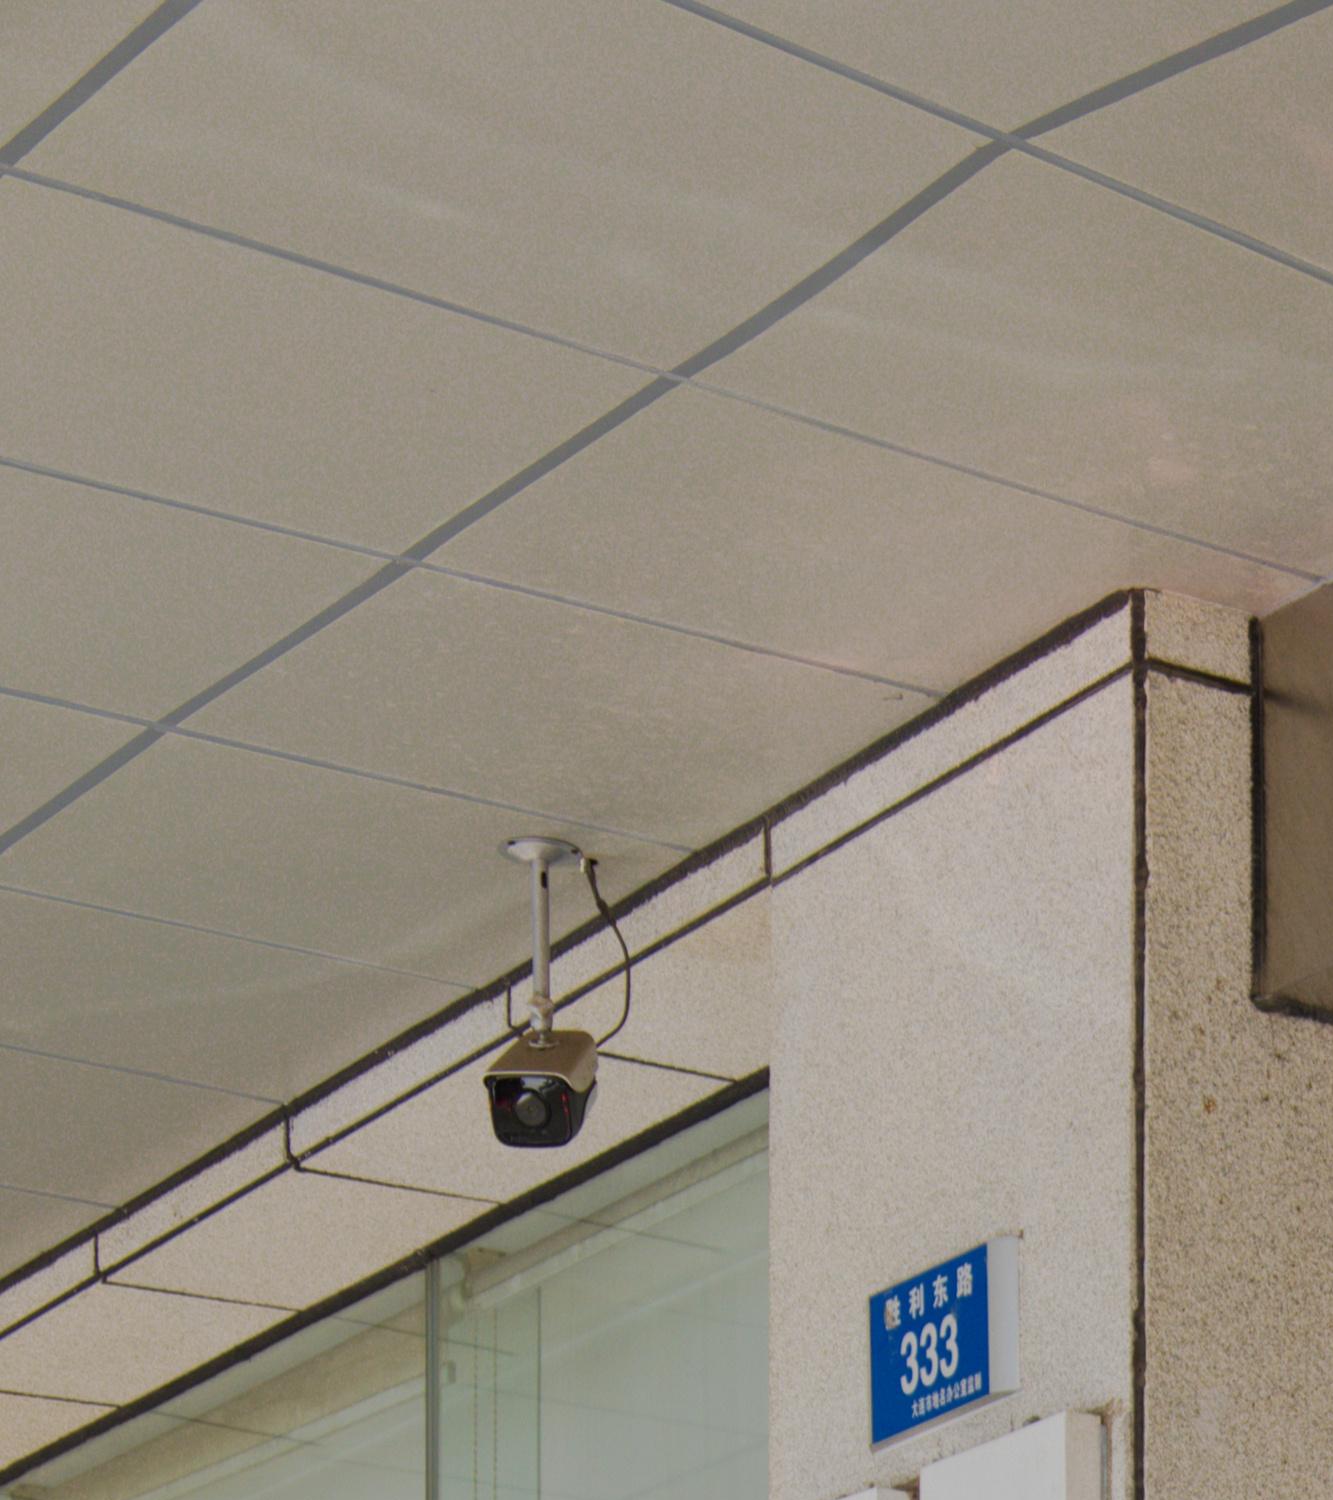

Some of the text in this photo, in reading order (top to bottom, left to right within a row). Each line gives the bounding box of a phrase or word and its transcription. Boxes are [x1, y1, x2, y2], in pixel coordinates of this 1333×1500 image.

[884, 1262, 974, 1331] 胜利东路
[900, 1313, 960, 1396] 333
